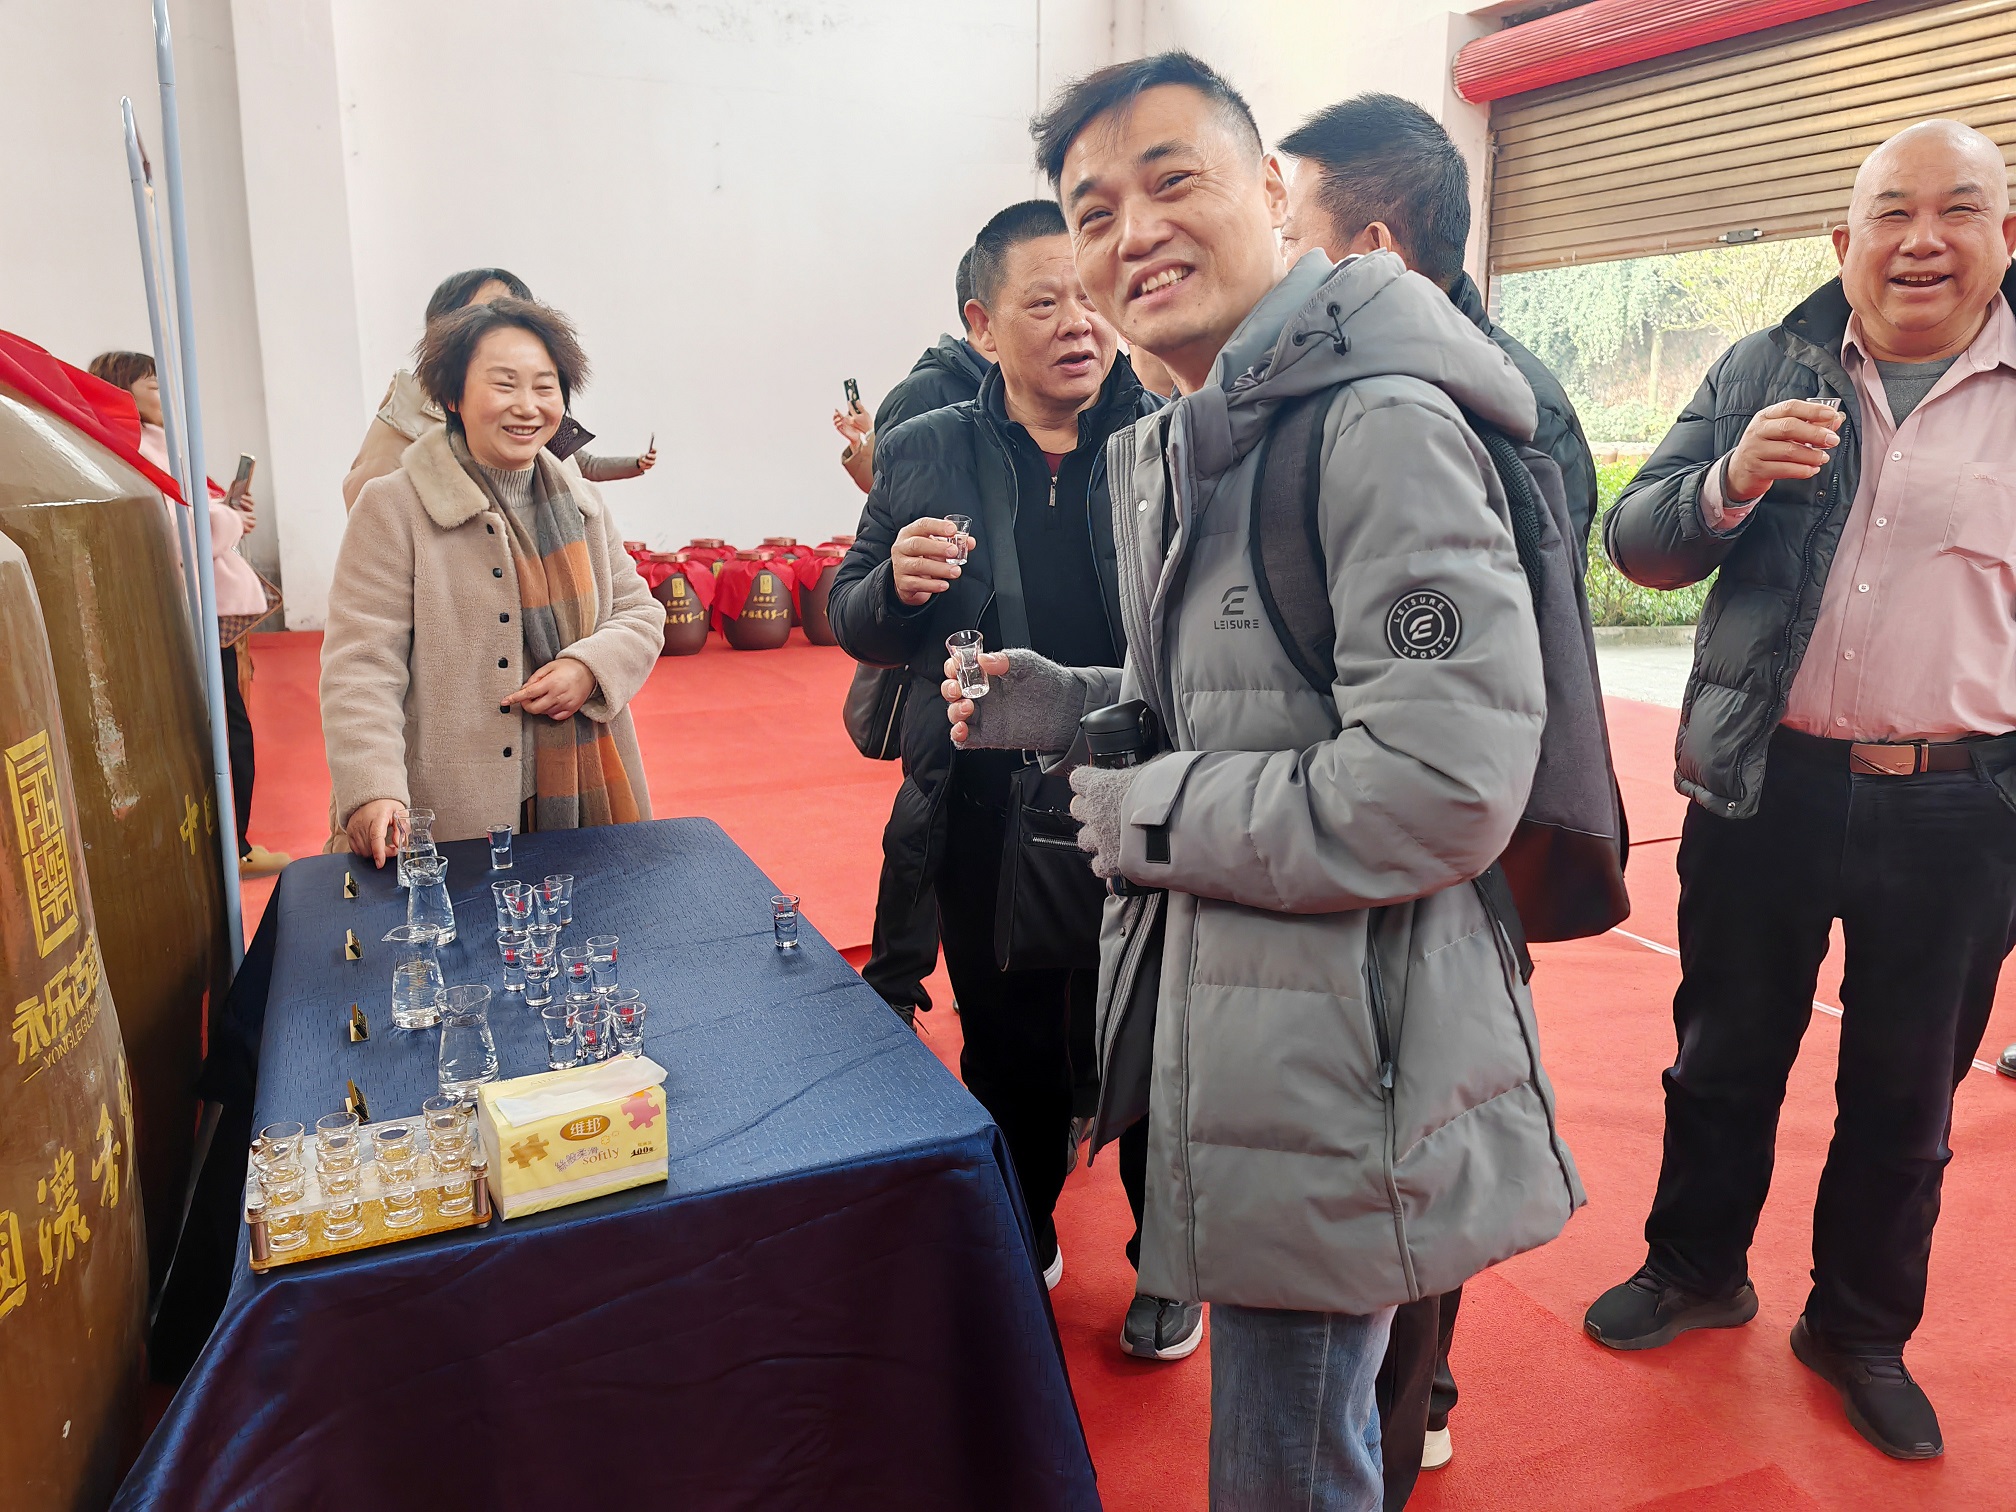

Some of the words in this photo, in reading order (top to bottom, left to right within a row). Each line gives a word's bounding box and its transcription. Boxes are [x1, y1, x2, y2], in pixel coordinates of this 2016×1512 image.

[1393, 596, 1446, 624] LEISURE
[1213, 618, 1260, 630] LEISURE
[1402, 635, 1451, 659] SPORTS
[570, 1116, 602, 1136] 维邦
[582, 1147, 620, 1166] softly
